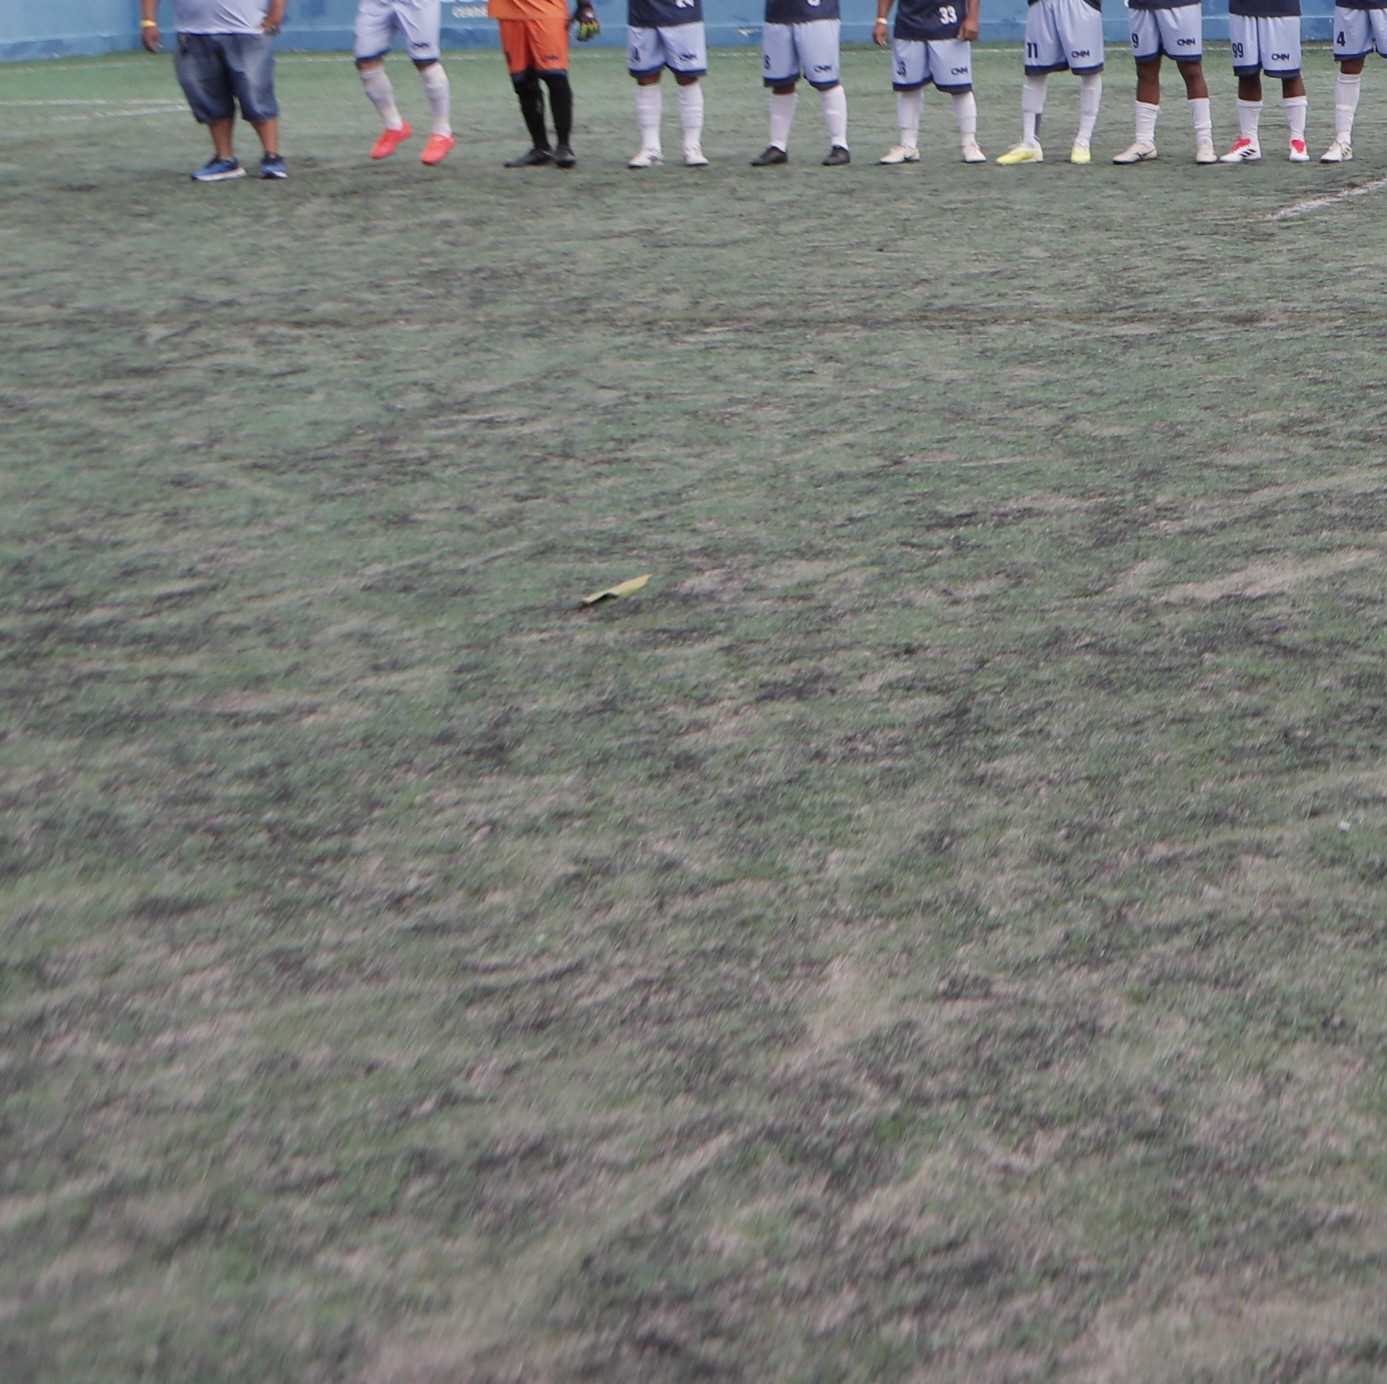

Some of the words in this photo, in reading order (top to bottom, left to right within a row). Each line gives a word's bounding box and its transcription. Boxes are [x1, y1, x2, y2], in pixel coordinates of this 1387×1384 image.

[938, 7, 957, 25] 33
[1132, 33, 1139, 48] 9
[1177, 38, 1195, 47] CMM
[1337, 31, 1346, 47] 4
[1027, 42, 1038, 58] 11
[1071, 50, 1090, 59] CMM
[1232, 43, 1244, 58] 99
[1271, 52, 1290, 61] CMM
